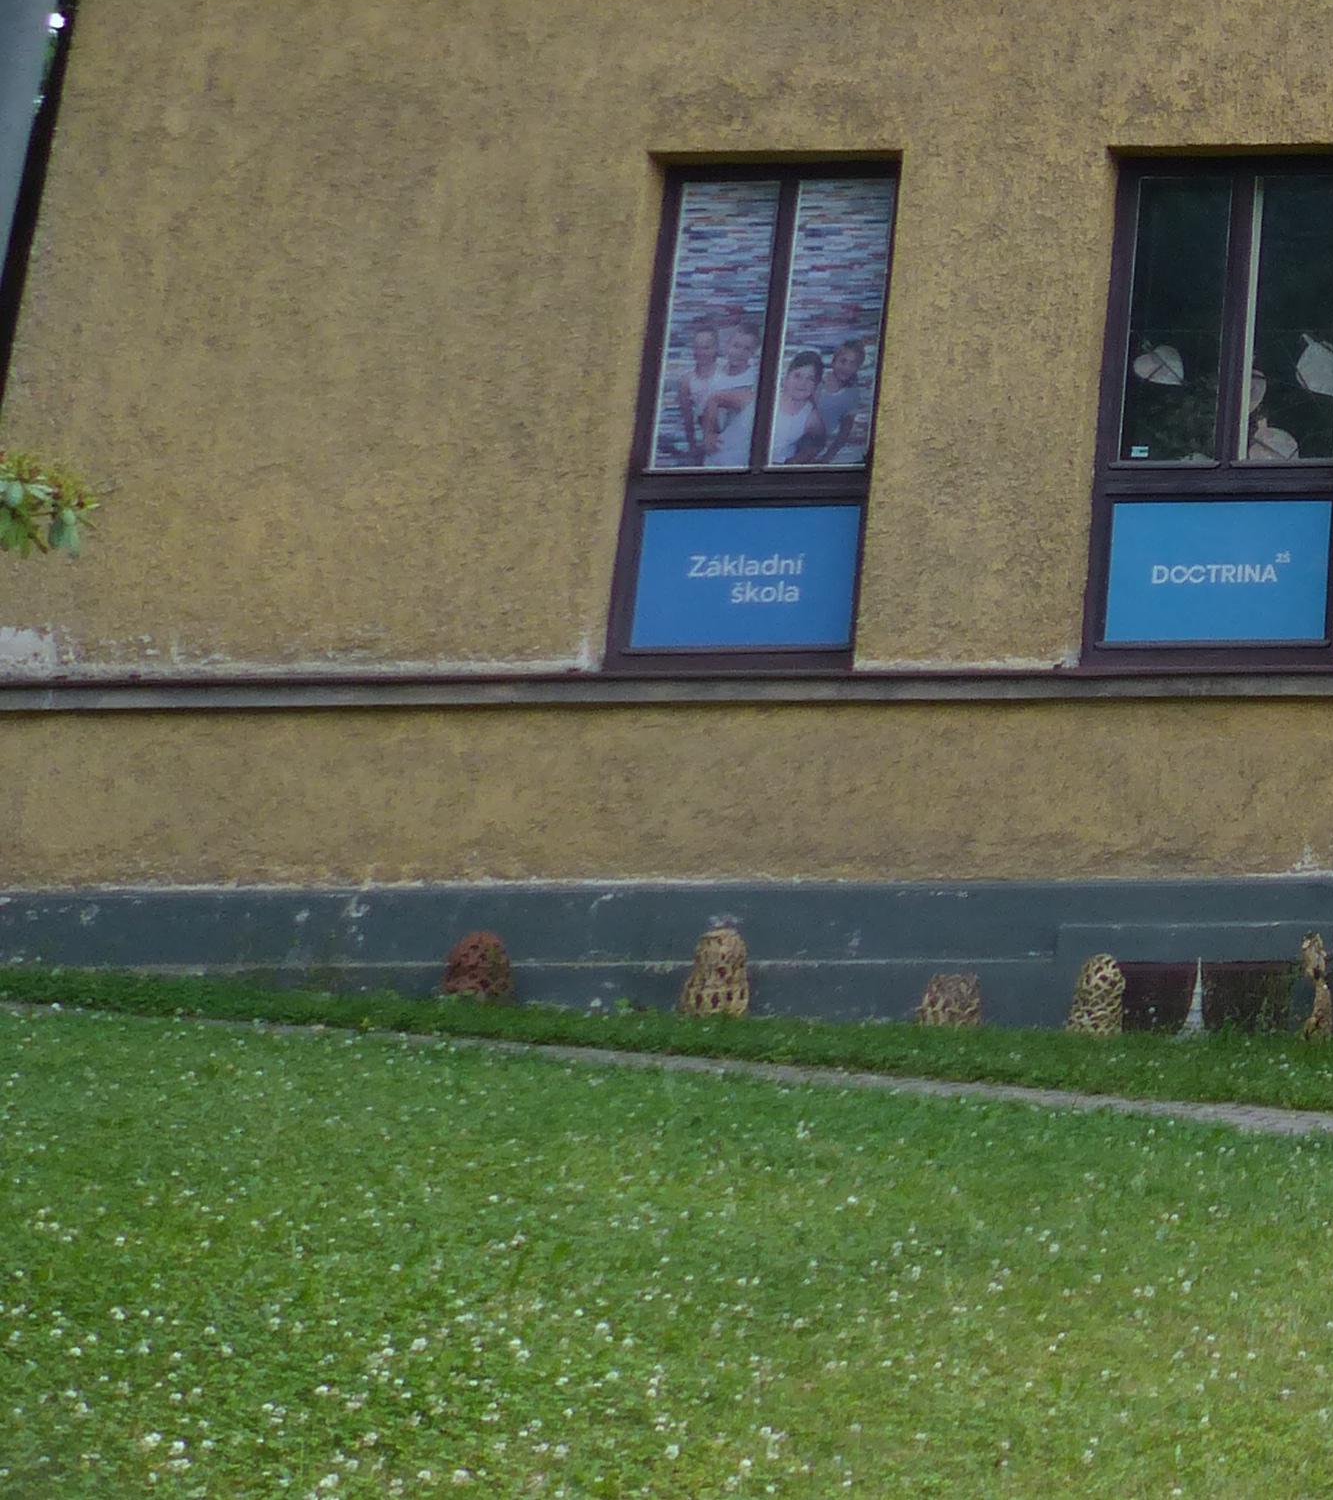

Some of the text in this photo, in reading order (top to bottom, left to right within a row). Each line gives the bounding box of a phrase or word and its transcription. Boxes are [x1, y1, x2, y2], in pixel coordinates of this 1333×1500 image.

[688, 553, 805, 577] Základní
[1151, 564, 1278, 584] DOCTRINA
[731, 581, 799, 603] škola
